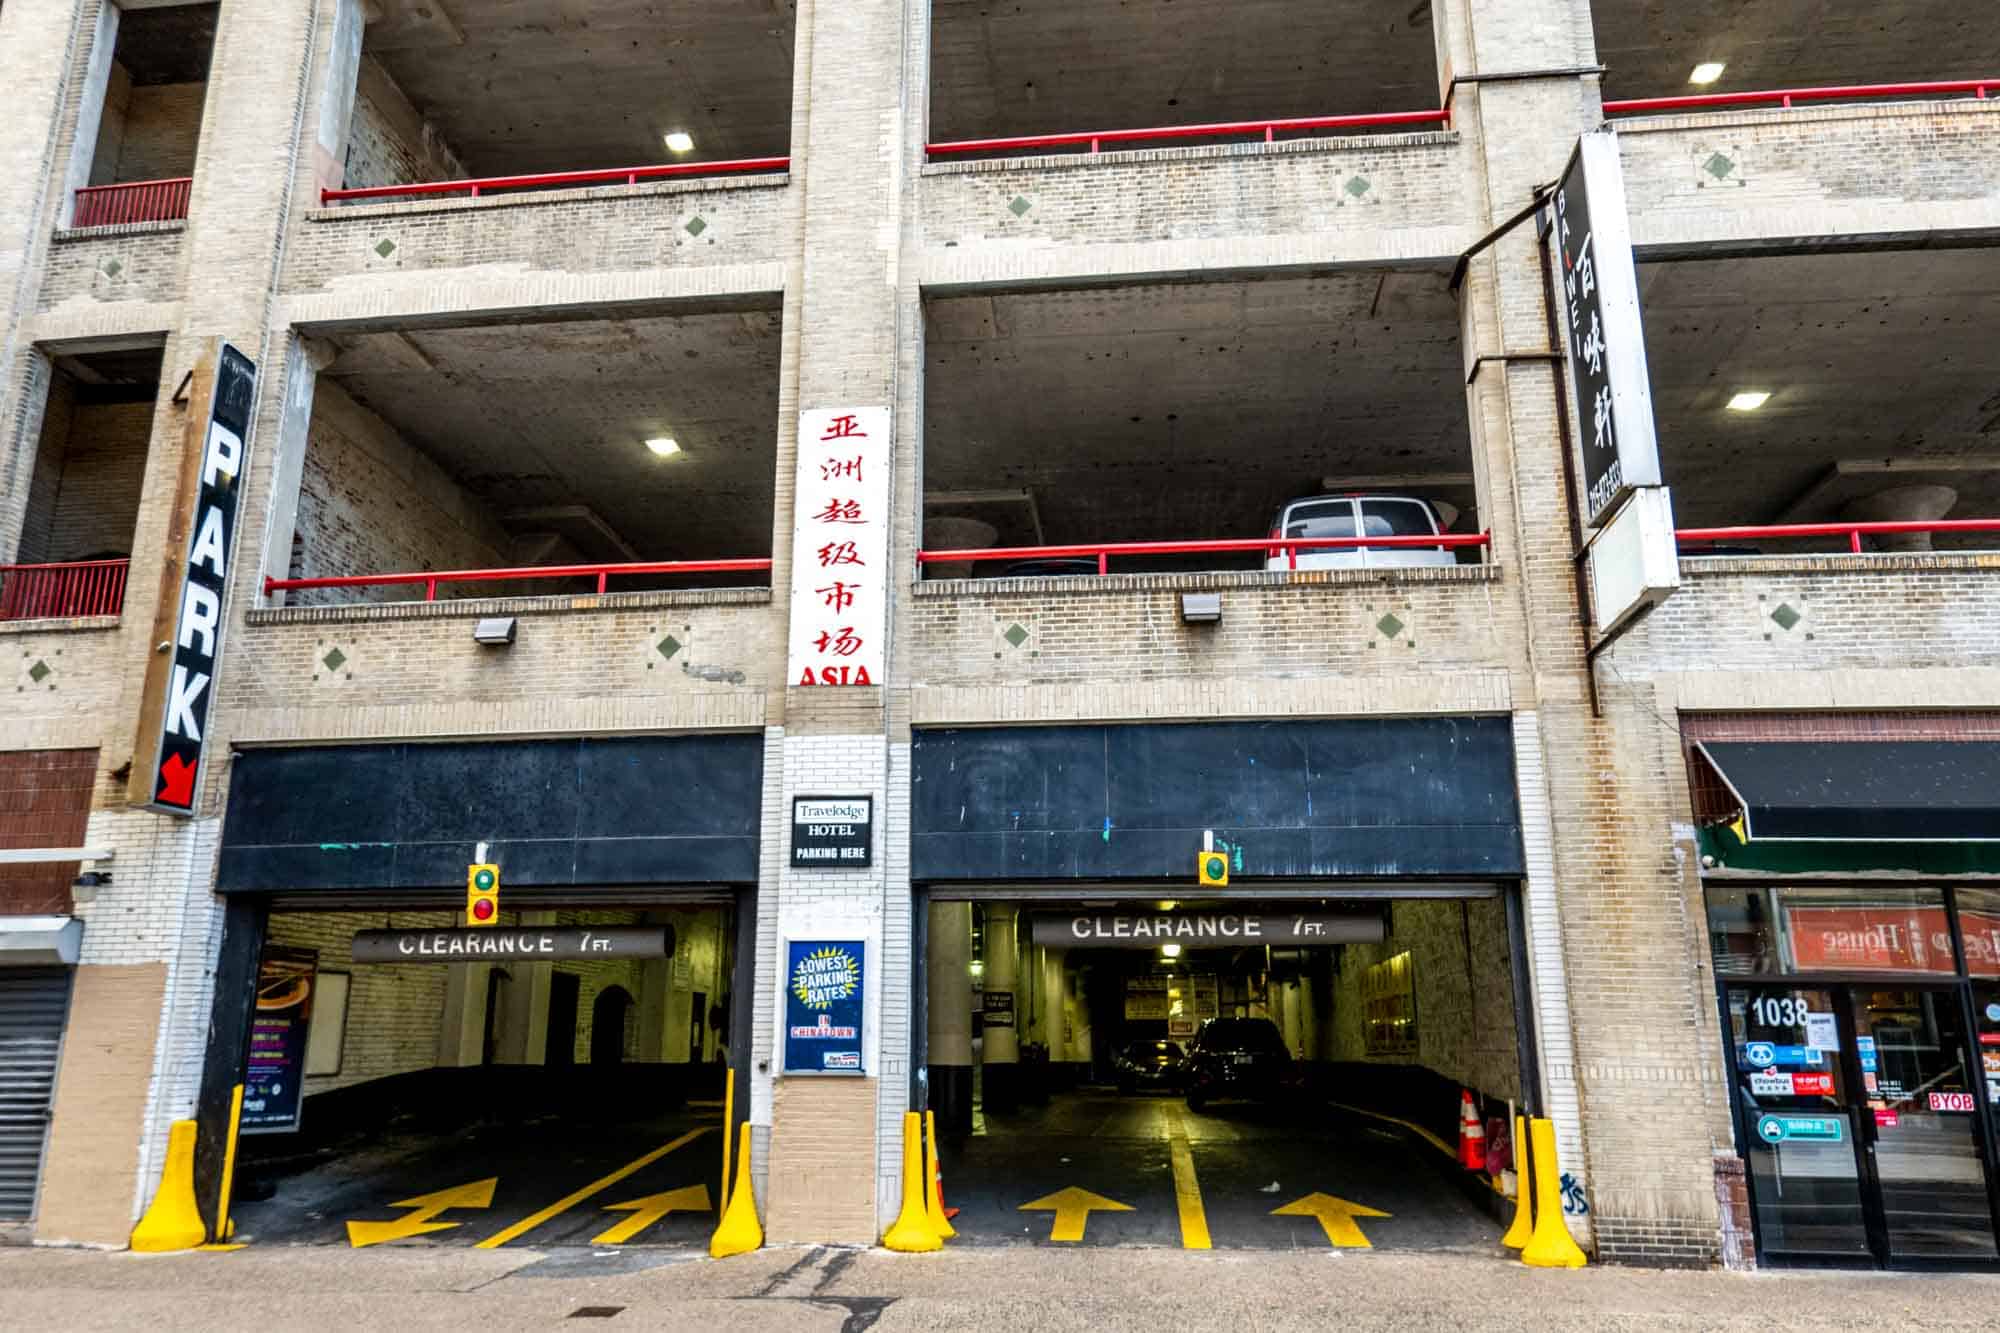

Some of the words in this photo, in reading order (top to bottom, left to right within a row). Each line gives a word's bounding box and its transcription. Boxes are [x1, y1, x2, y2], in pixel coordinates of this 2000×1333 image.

[811, 414, 869, 657] 亚洲超级市场
[165, 421, 242, 743] PARK
[800, 665, 871, 686] ASIA
[800, 804, 864, 820] Travelodge
[808, 825, 856, 836] HOTEL
[796, 847, 838, 859] PARKING
[840, 847, 865, 858] HERE
[1071, 915, 1262, 938] CLEARANCE
[1292, 916, 1304, 936] 7
[1304, 922, 1327, 937] FT.
[399, 932, 553, 954] CLEARANCE
[580, 931, 592, 952] 7
[592, 938, 613, 952] FT.
[800, 954, 849, 974] LOWEST
[799, 970, 853, 988] PARKING
[807, 985, 847, 1003] RATES
[819, 1014, 830, 1025] IN
[1752, 997, 1808, 1027] 1038
[792, 1027, 853, 1038] CHINATOWN
[1930, 1093, 1974, 1110] BYOB
